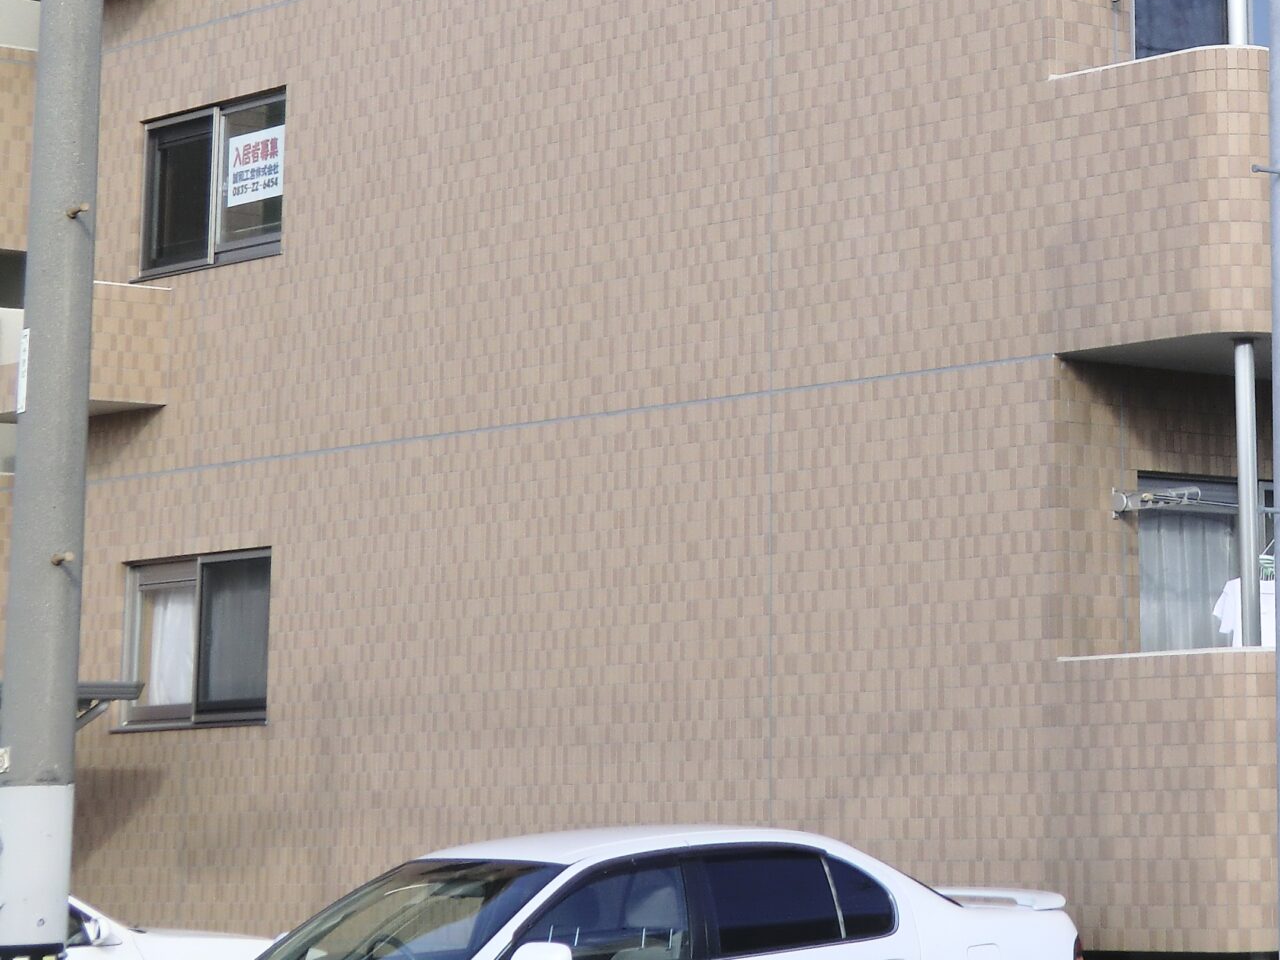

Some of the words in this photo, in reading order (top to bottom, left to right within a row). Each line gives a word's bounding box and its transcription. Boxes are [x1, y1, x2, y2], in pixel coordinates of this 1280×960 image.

[233, 137, 279, 168] 入居者募集
[232, 177, 279, 196] 0835-22-6454
